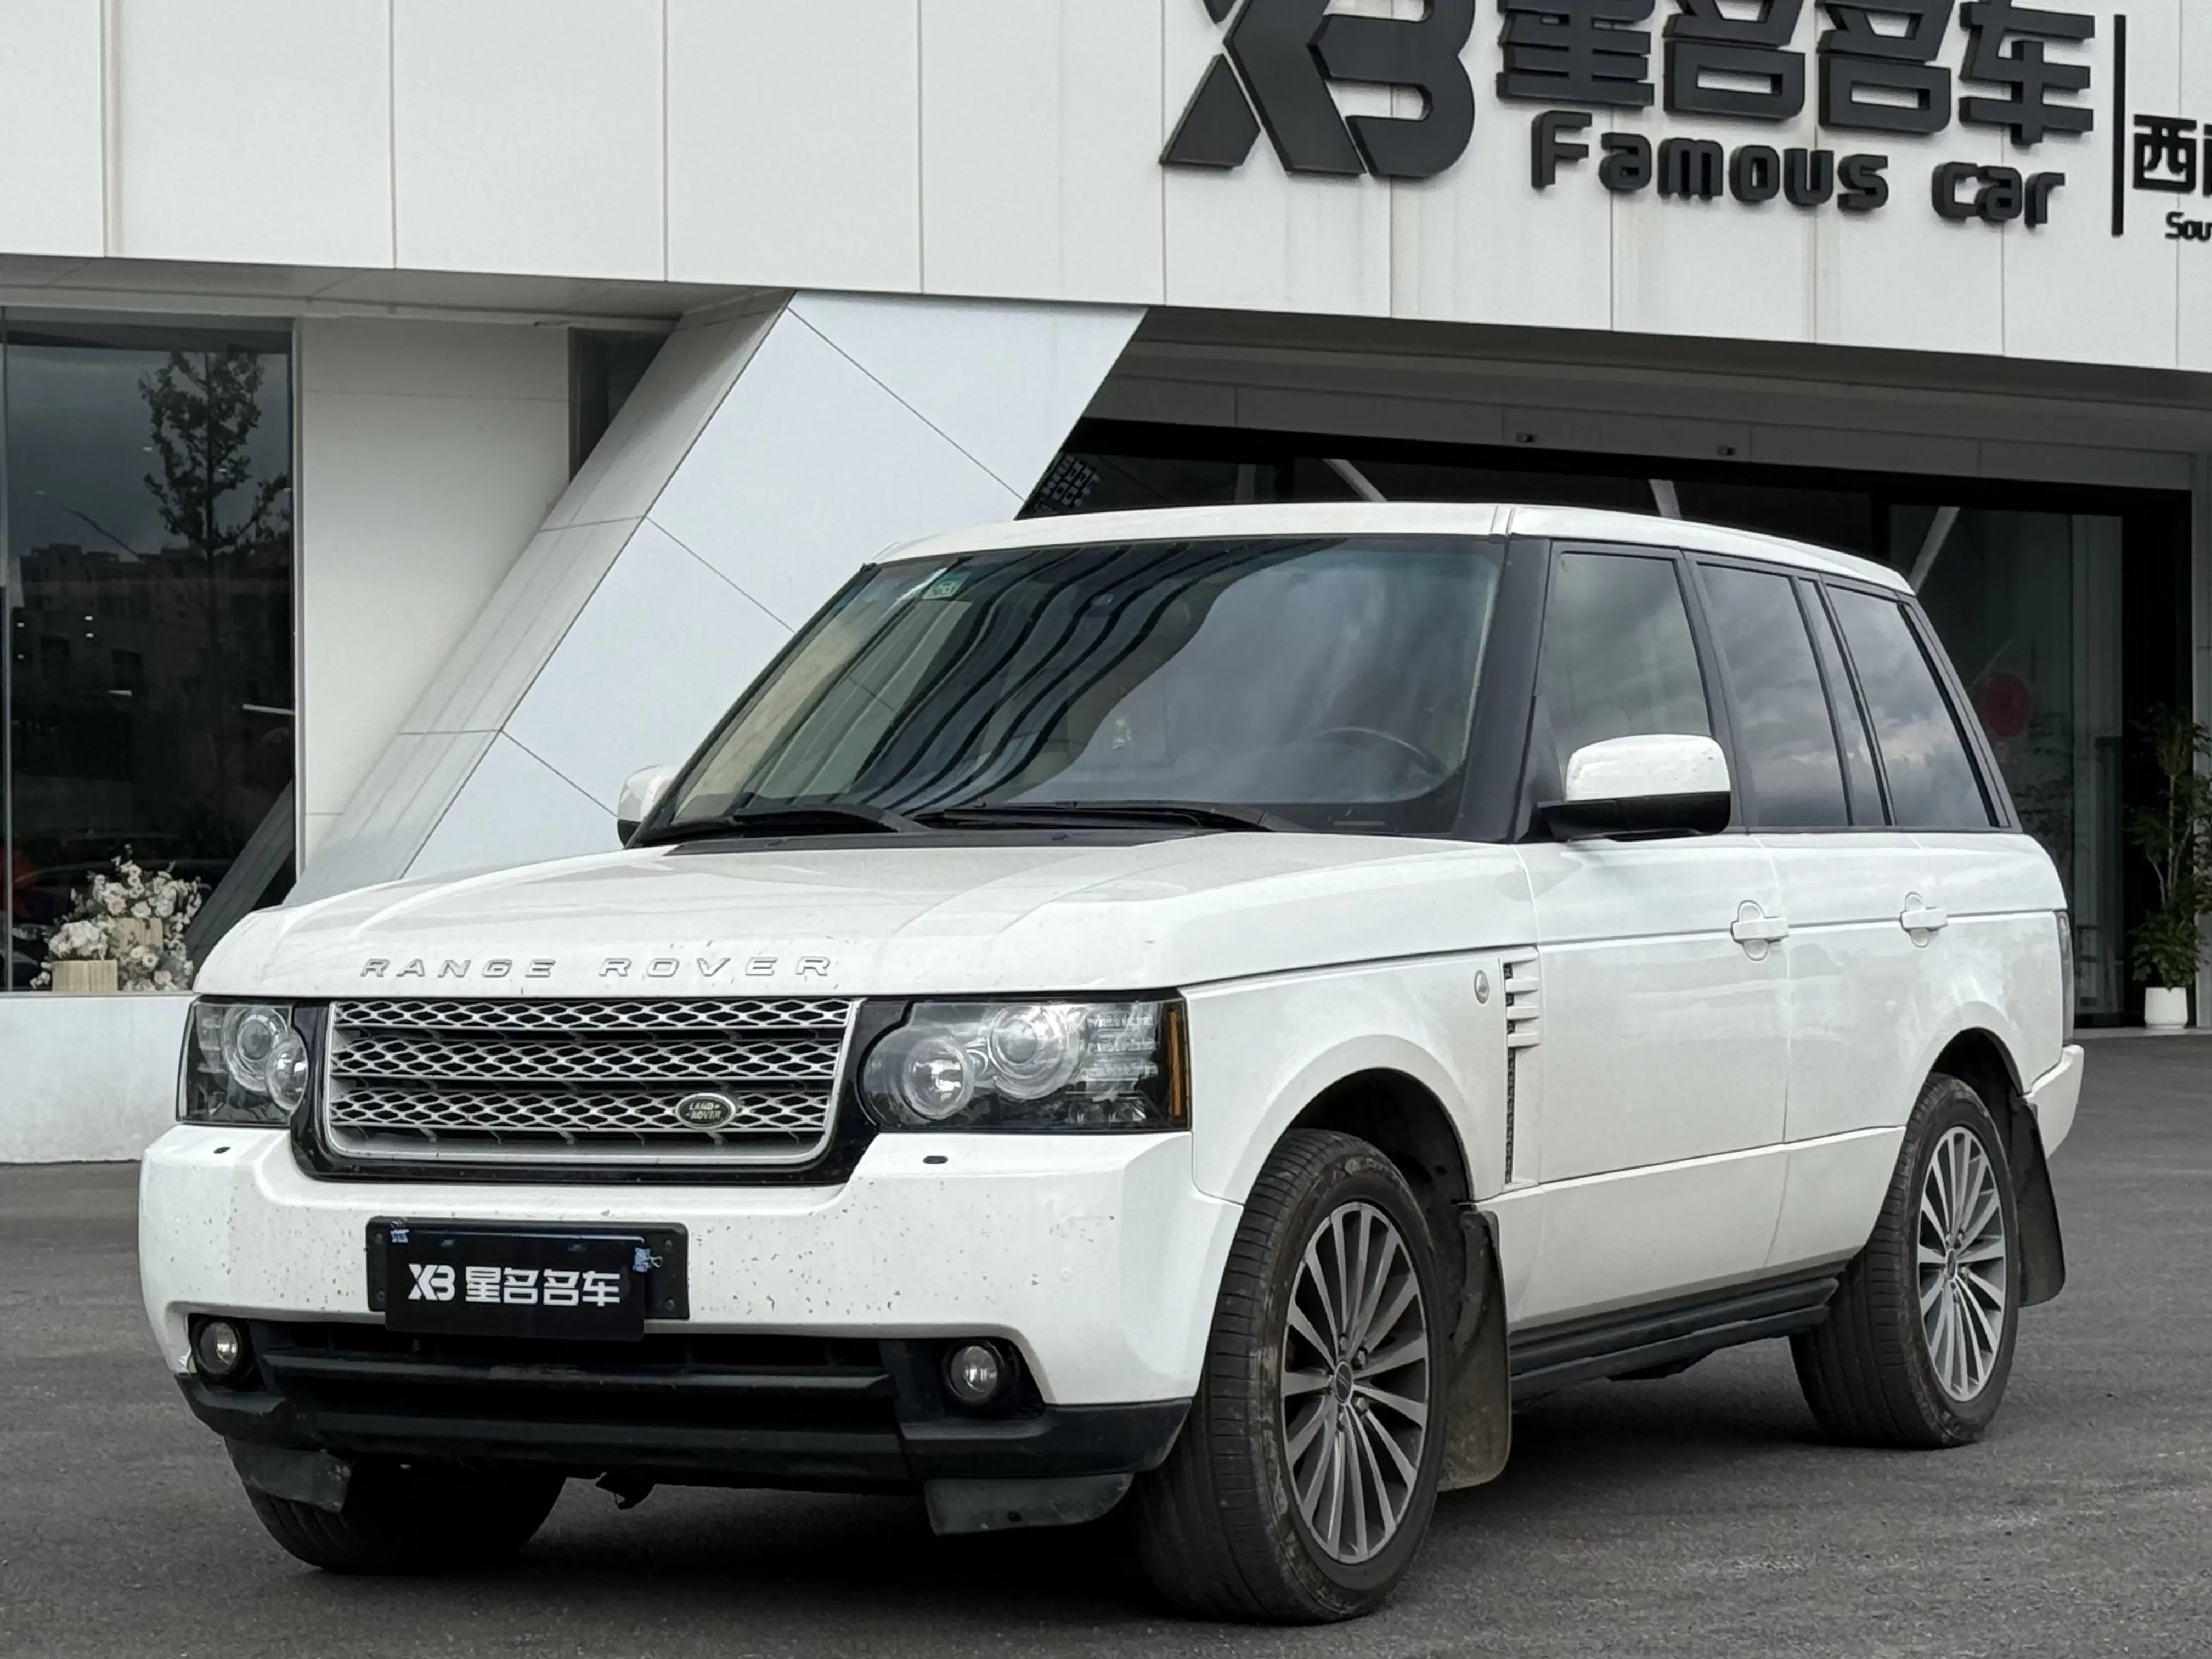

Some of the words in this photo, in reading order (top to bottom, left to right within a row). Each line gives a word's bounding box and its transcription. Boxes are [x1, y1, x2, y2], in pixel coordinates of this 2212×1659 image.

[1531, 110, 1891, 211] Famous
[1931, 161, 2065, 228] car
[2133, 114, 2212, 198] 西
[359, 958, 556, 978] RANGE
[598, 956, 831, 977] ROVER
[689, 1102, 714, 1110] LAND
[465, 1266, 621, 1306] 星名名车
